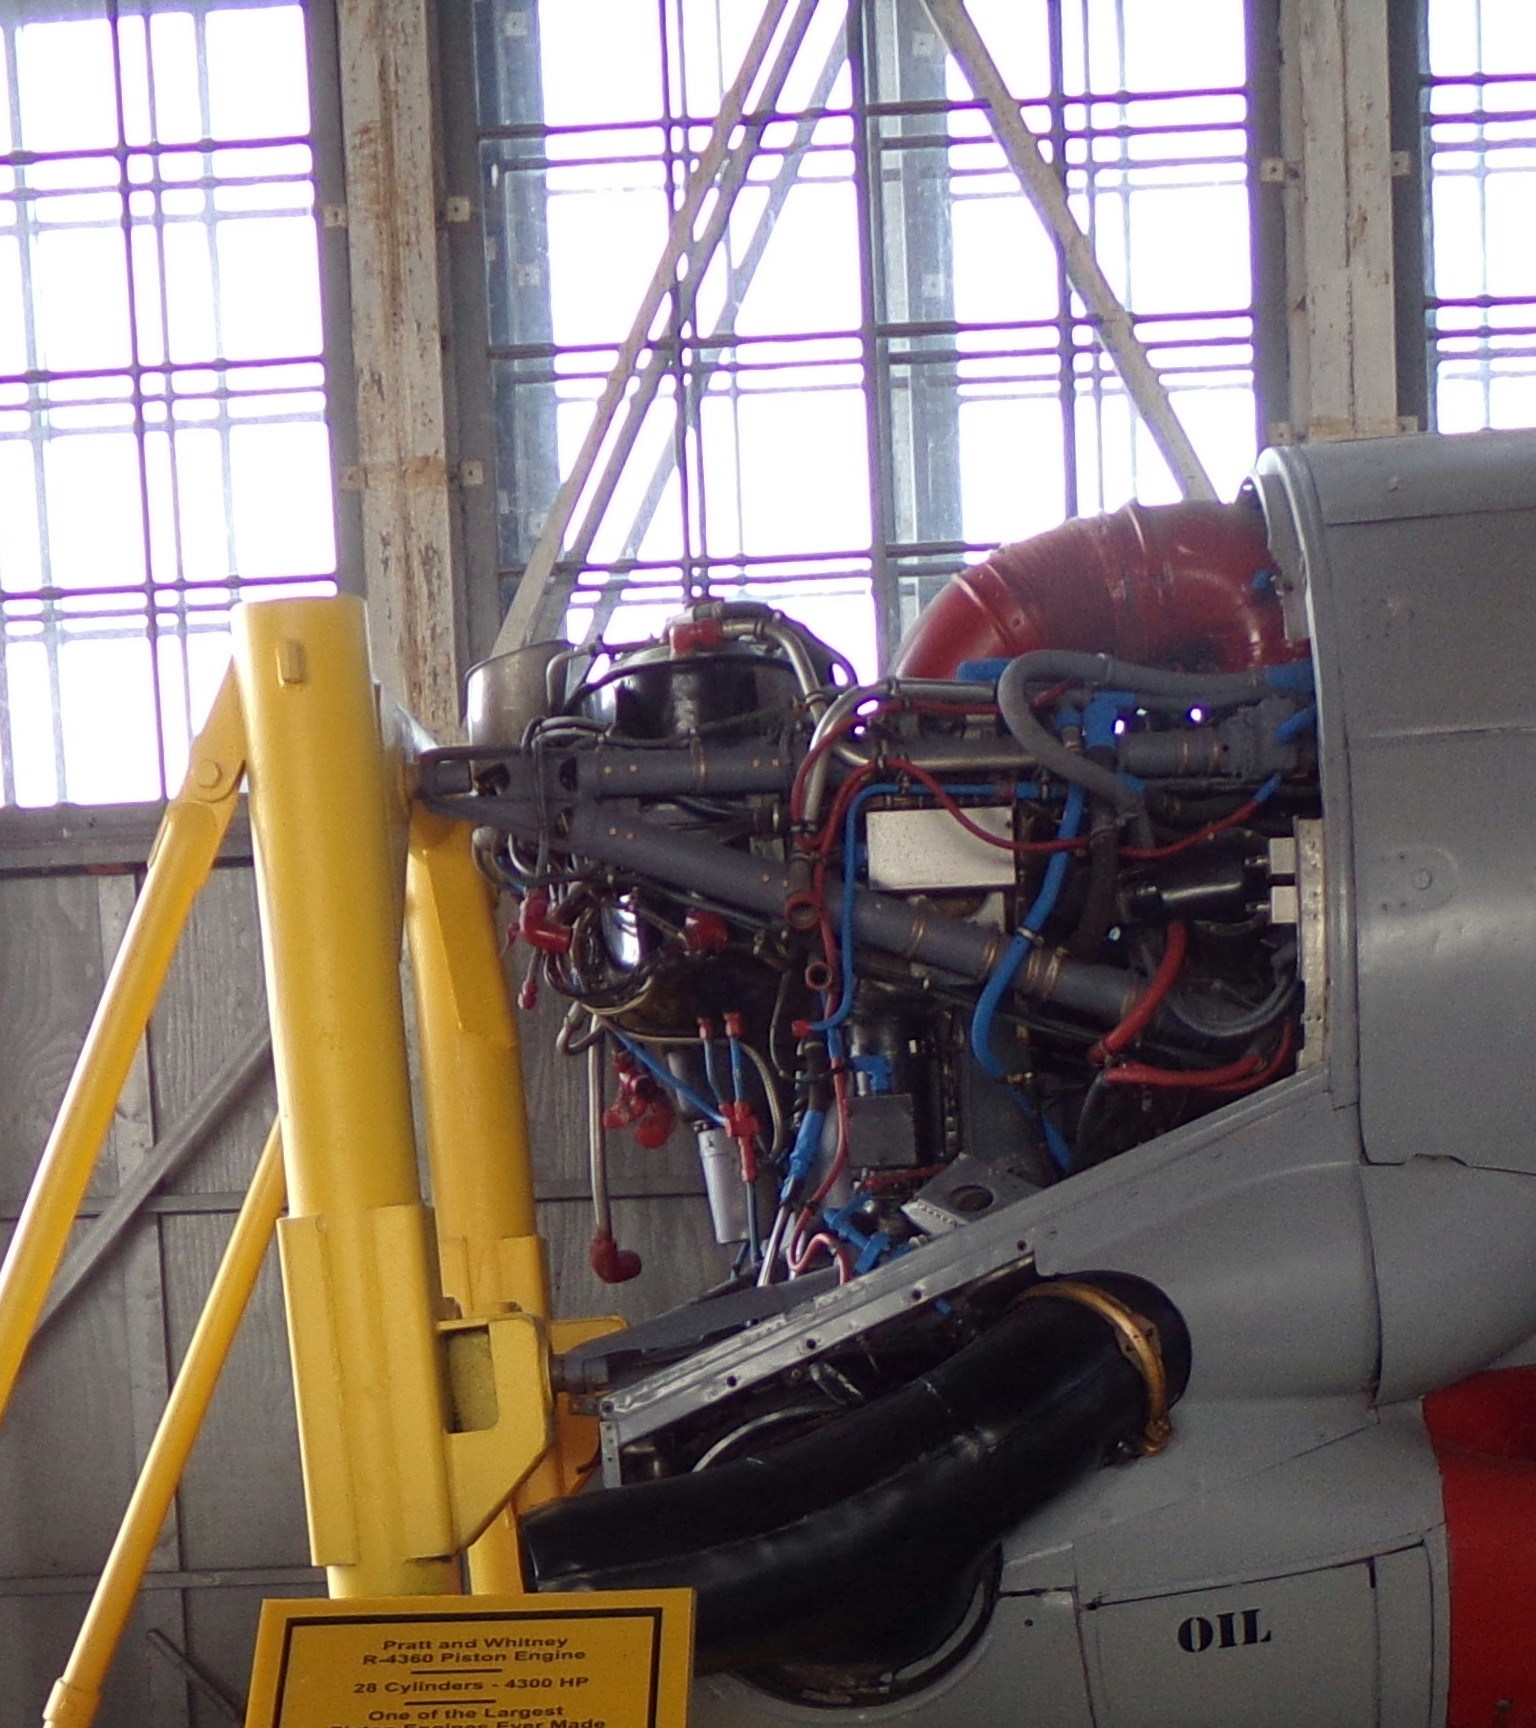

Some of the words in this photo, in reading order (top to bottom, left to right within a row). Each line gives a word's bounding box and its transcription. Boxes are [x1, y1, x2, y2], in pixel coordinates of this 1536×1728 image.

[1177, 1608, 1271, 1653] OIL
[383, 1640, 433, 1651] Pratt
[439, 1639, 478, 1649] and
[484, 1637, 569, 1650] Whitney
[363, 1653, 434, 1665] R-4360
[440, 1652, 507, 1663] Piston
[514, 1650, 587, 1663] Engine
[354, 1683, 378, 1694] 28
[385, 1680, 484, 1695] Cylinders
[505, 1678, 553, 1689] 4300
[559, 1676, 590, 1688] HP
[368, 1710, 411, 1721] One
[417, 1709, 440, 1720] of
[445, 1708, 476, 1719] the
[485, 1706, 564, 1720] Largest
